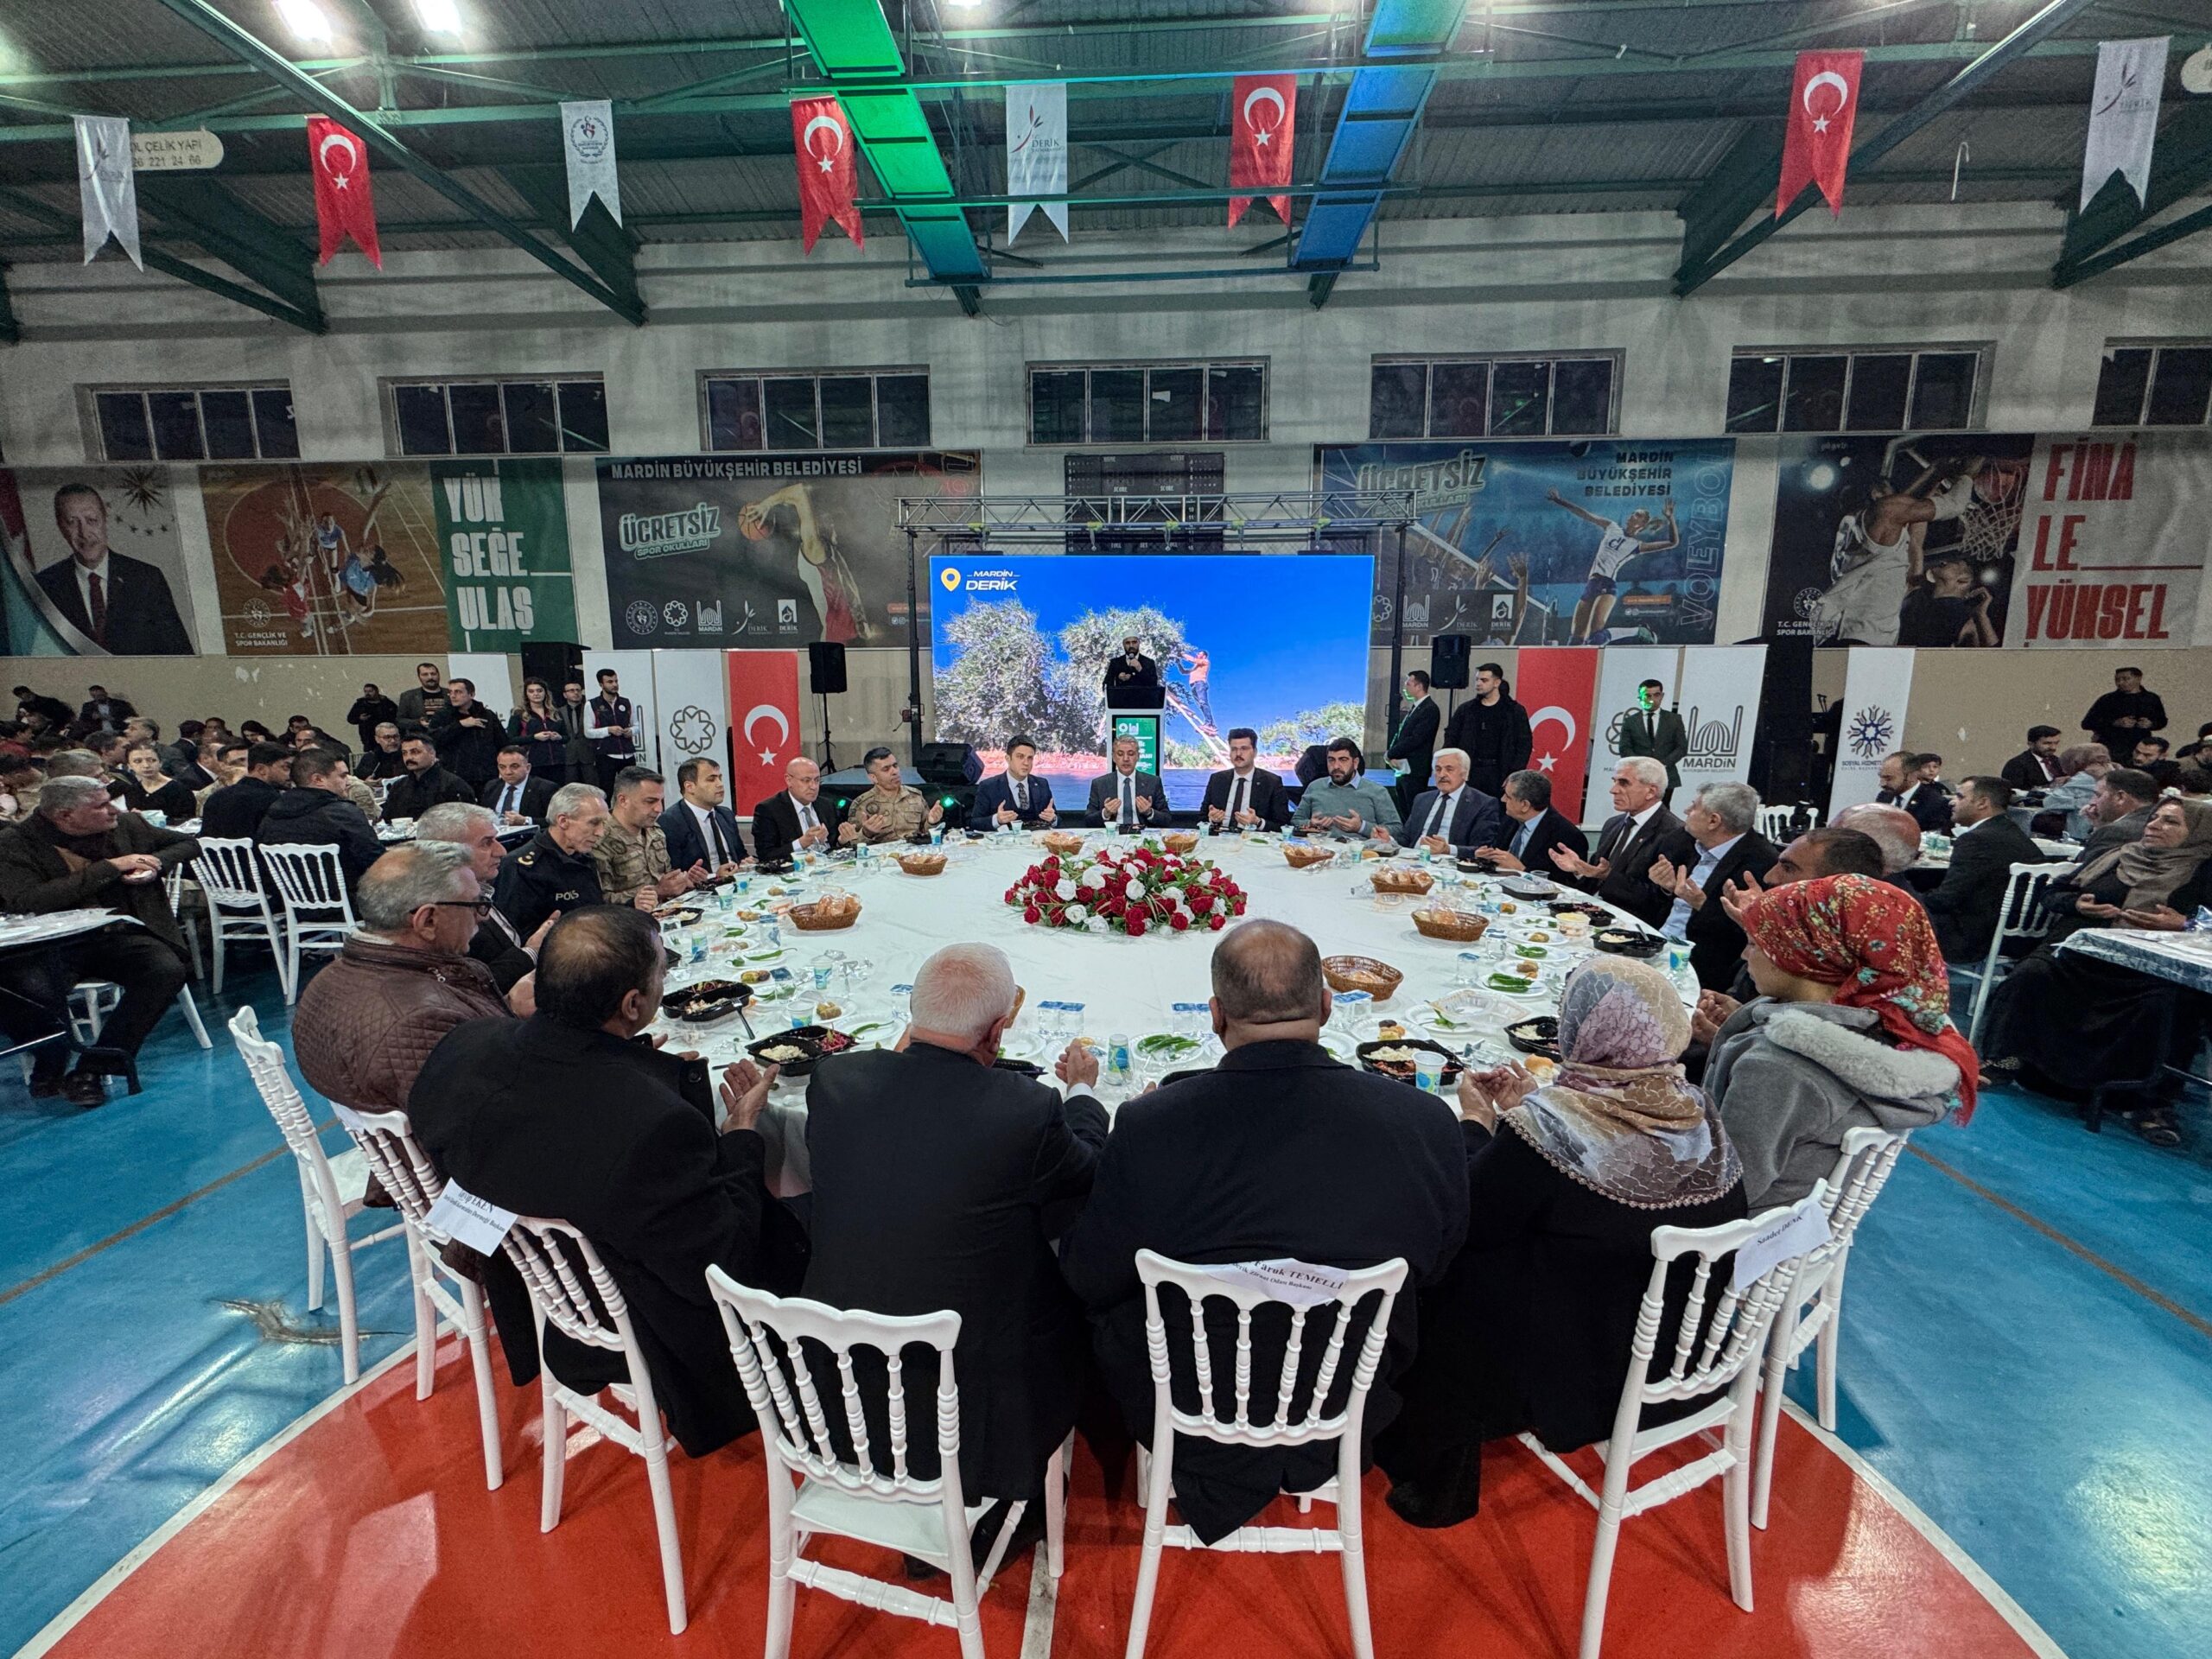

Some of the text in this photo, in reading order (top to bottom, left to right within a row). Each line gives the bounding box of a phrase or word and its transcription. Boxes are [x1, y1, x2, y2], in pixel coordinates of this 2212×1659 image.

[612, 455, 862, 481] MARDİN BÜYÜKŞEHİR BELEDİYESİ
[1577, 465, 1673, 482] BÜYÜKŞEHİR
[1616, 450, 1675, 464] MARDİN
[2043, 437, 2137, 501] FİNA
[442, 472, 505, 523] YÜK
[1585, 483, 1671, 498] BELEDİYESİ
[620, 503, 721, 548] ÜCRETSİZ
[2031, 514, 2087, 572] LE
[637, 538, 709, 556] SPOR OKULLARI
[965, 577, 1019, 591] DERİK
[456, 586, 534, 635] ULAŞ
[2025, 579, 2170, 641] YÜKSEL
